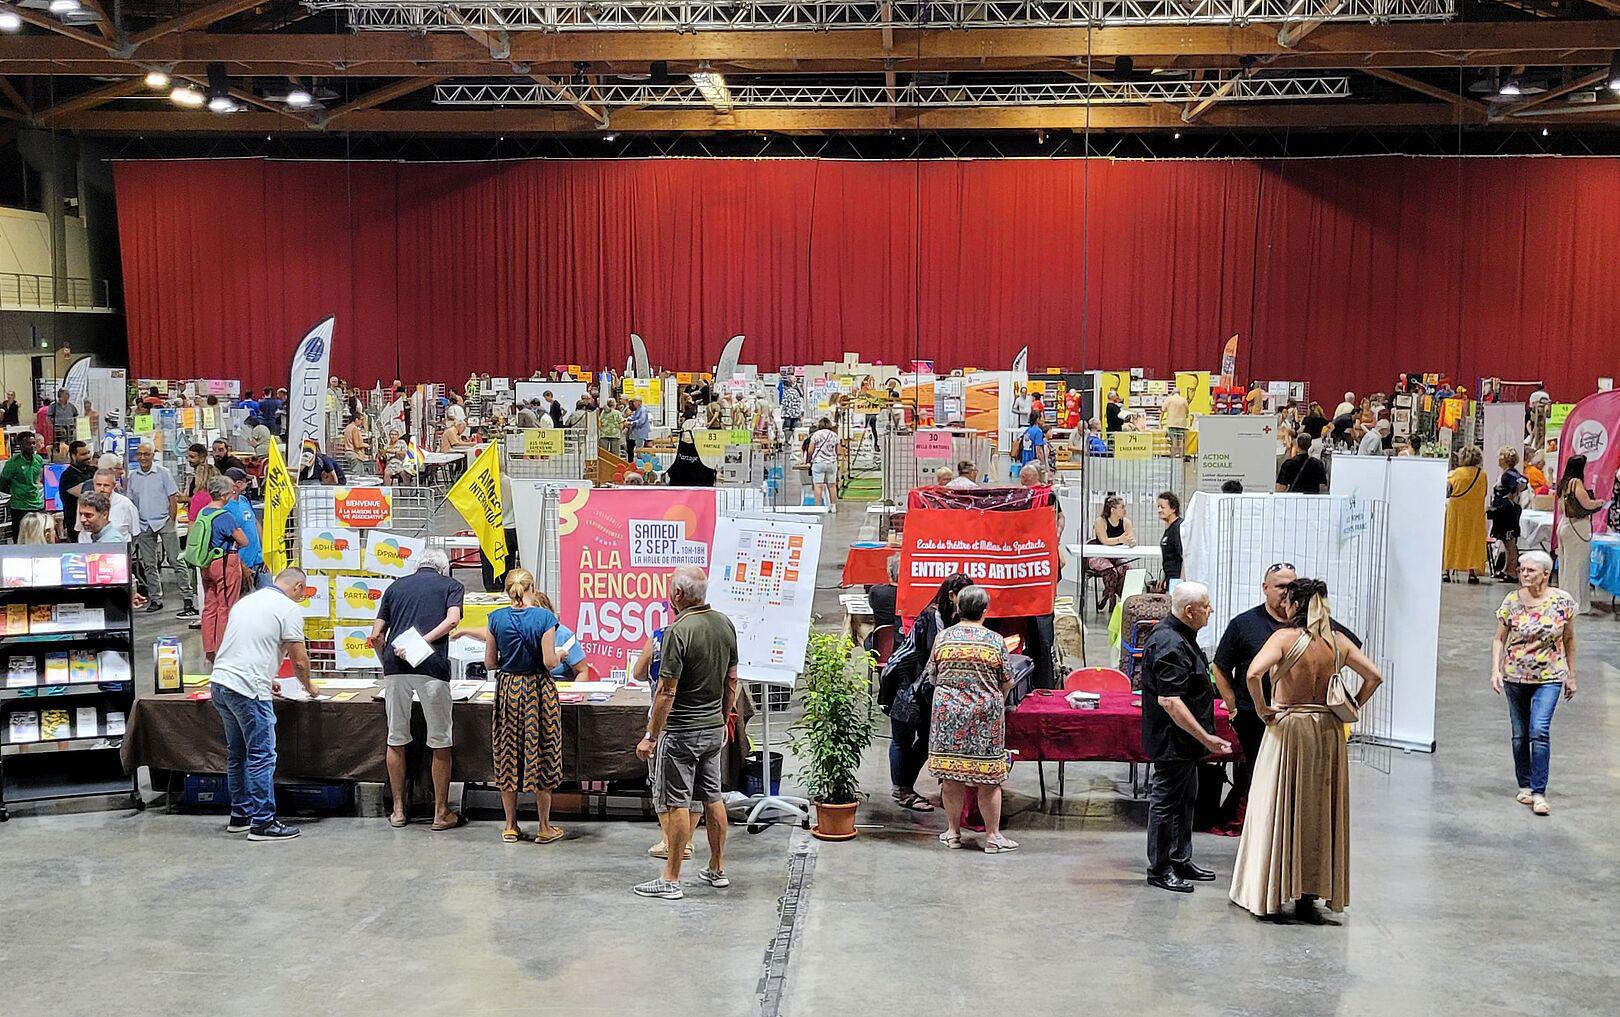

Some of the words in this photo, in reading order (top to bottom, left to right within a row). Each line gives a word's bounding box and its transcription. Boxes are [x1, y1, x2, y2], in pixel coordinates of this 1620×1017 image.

[303, 367, 321, 441] RACETI
[537, 430, 546, 439] 70
[708, 433, 717, 441] 83
[929, 433, 938, 441] 30
[1129, 435, 1137, 443] 74
[634, 524, 679, 539] SAMEDI
[313, 542, 350, 551] ADHÉRER
[634, 539, 642, 555] 2
[646, 539, 680, 555] SEPT.
[681, 546, 705, 555] 10H-18H
[937, 540, 946, 550] de
[971, 540, 980, 550] et
[1002, 541, 1013, 551] du
[1012, 538, 1046, 555] Spectacle
[377, 549, 409, 561] EXPRIMER
[579, 545, 593, 569] À
[596, 550, 622, 570] LA
[634, 556, 642, 564] LA
[643, 556, 661, 564] HALLE
[662, 556, 669, 564] DE
[670, 556, 705, 564] MARTIGUES
[988, 559, 1051, 580] ARTISTES
[343, 591, 382, 599] PARTAGER
